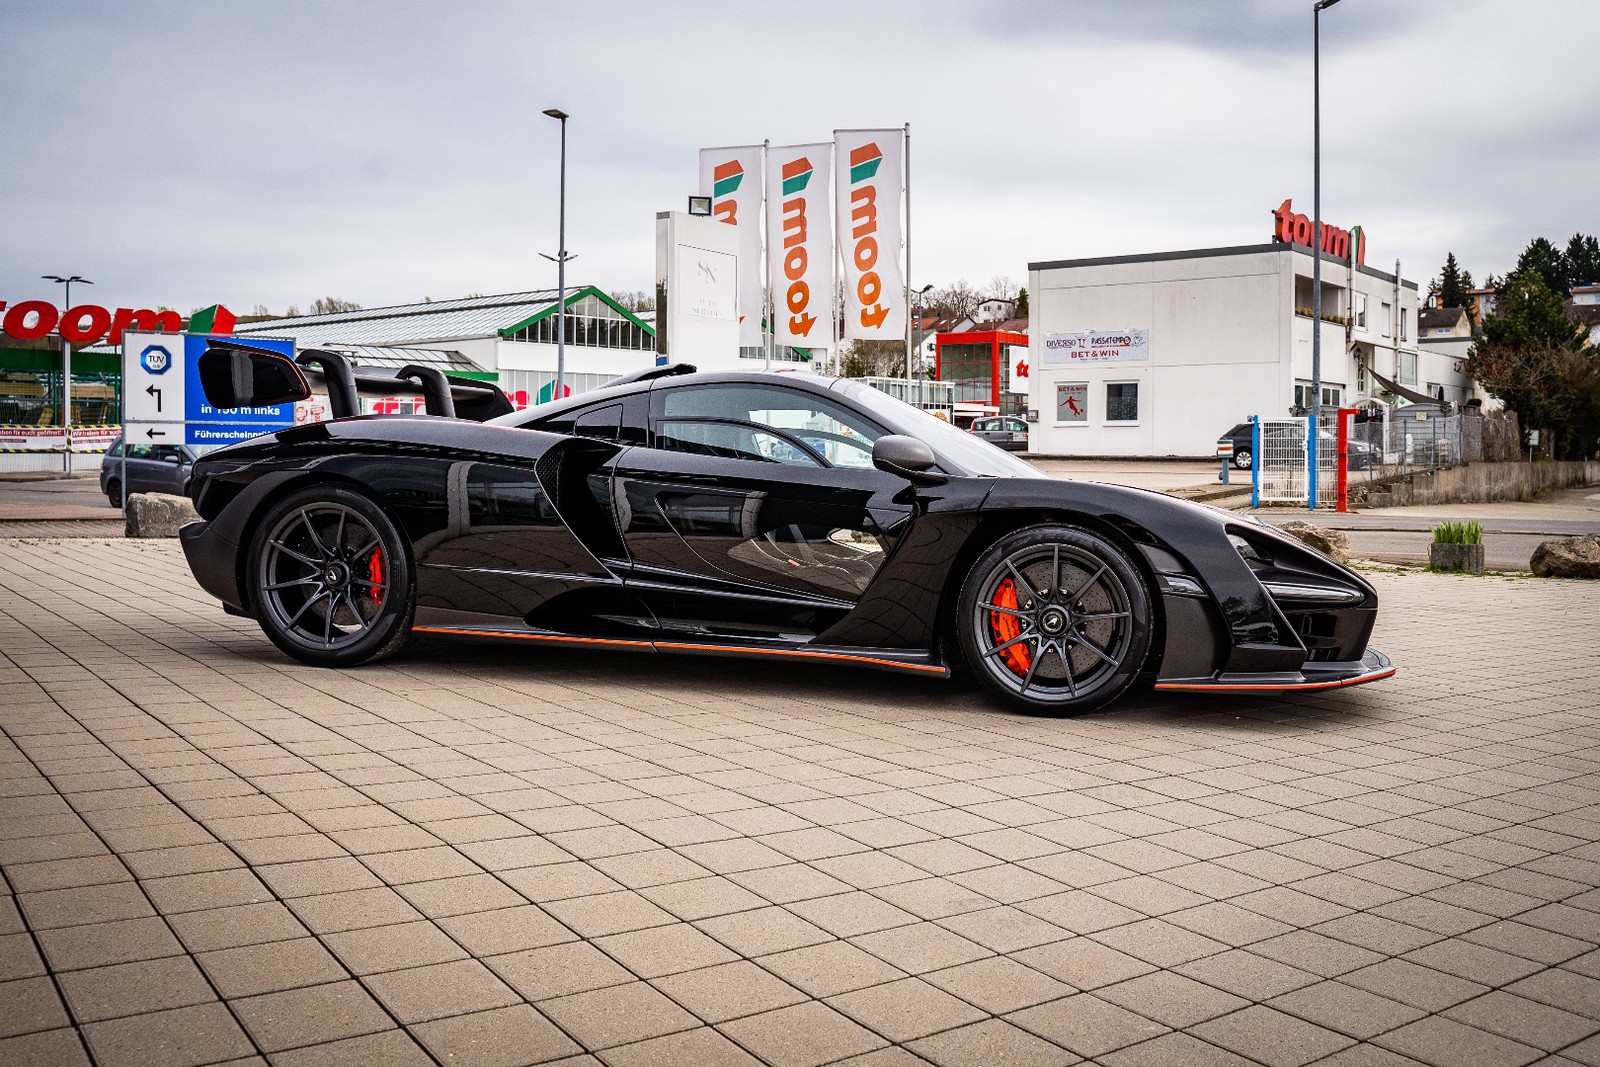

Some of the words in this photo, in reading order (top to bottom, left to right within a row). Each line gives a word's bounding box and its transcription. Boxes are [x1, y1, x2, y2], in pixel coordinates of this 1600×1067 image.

[1275, 198, 1349, 260] toom
[783, 197, 817, 337] toom
[851, 185, 890, 329] toom
[0, 300, 182, 344] oom
[1091, 336, 1131, 345] PASSATEMPO
[201, 404, 212, 414] in
[240, 406, 252, 415] m
[254, 405, 280, 416] links
